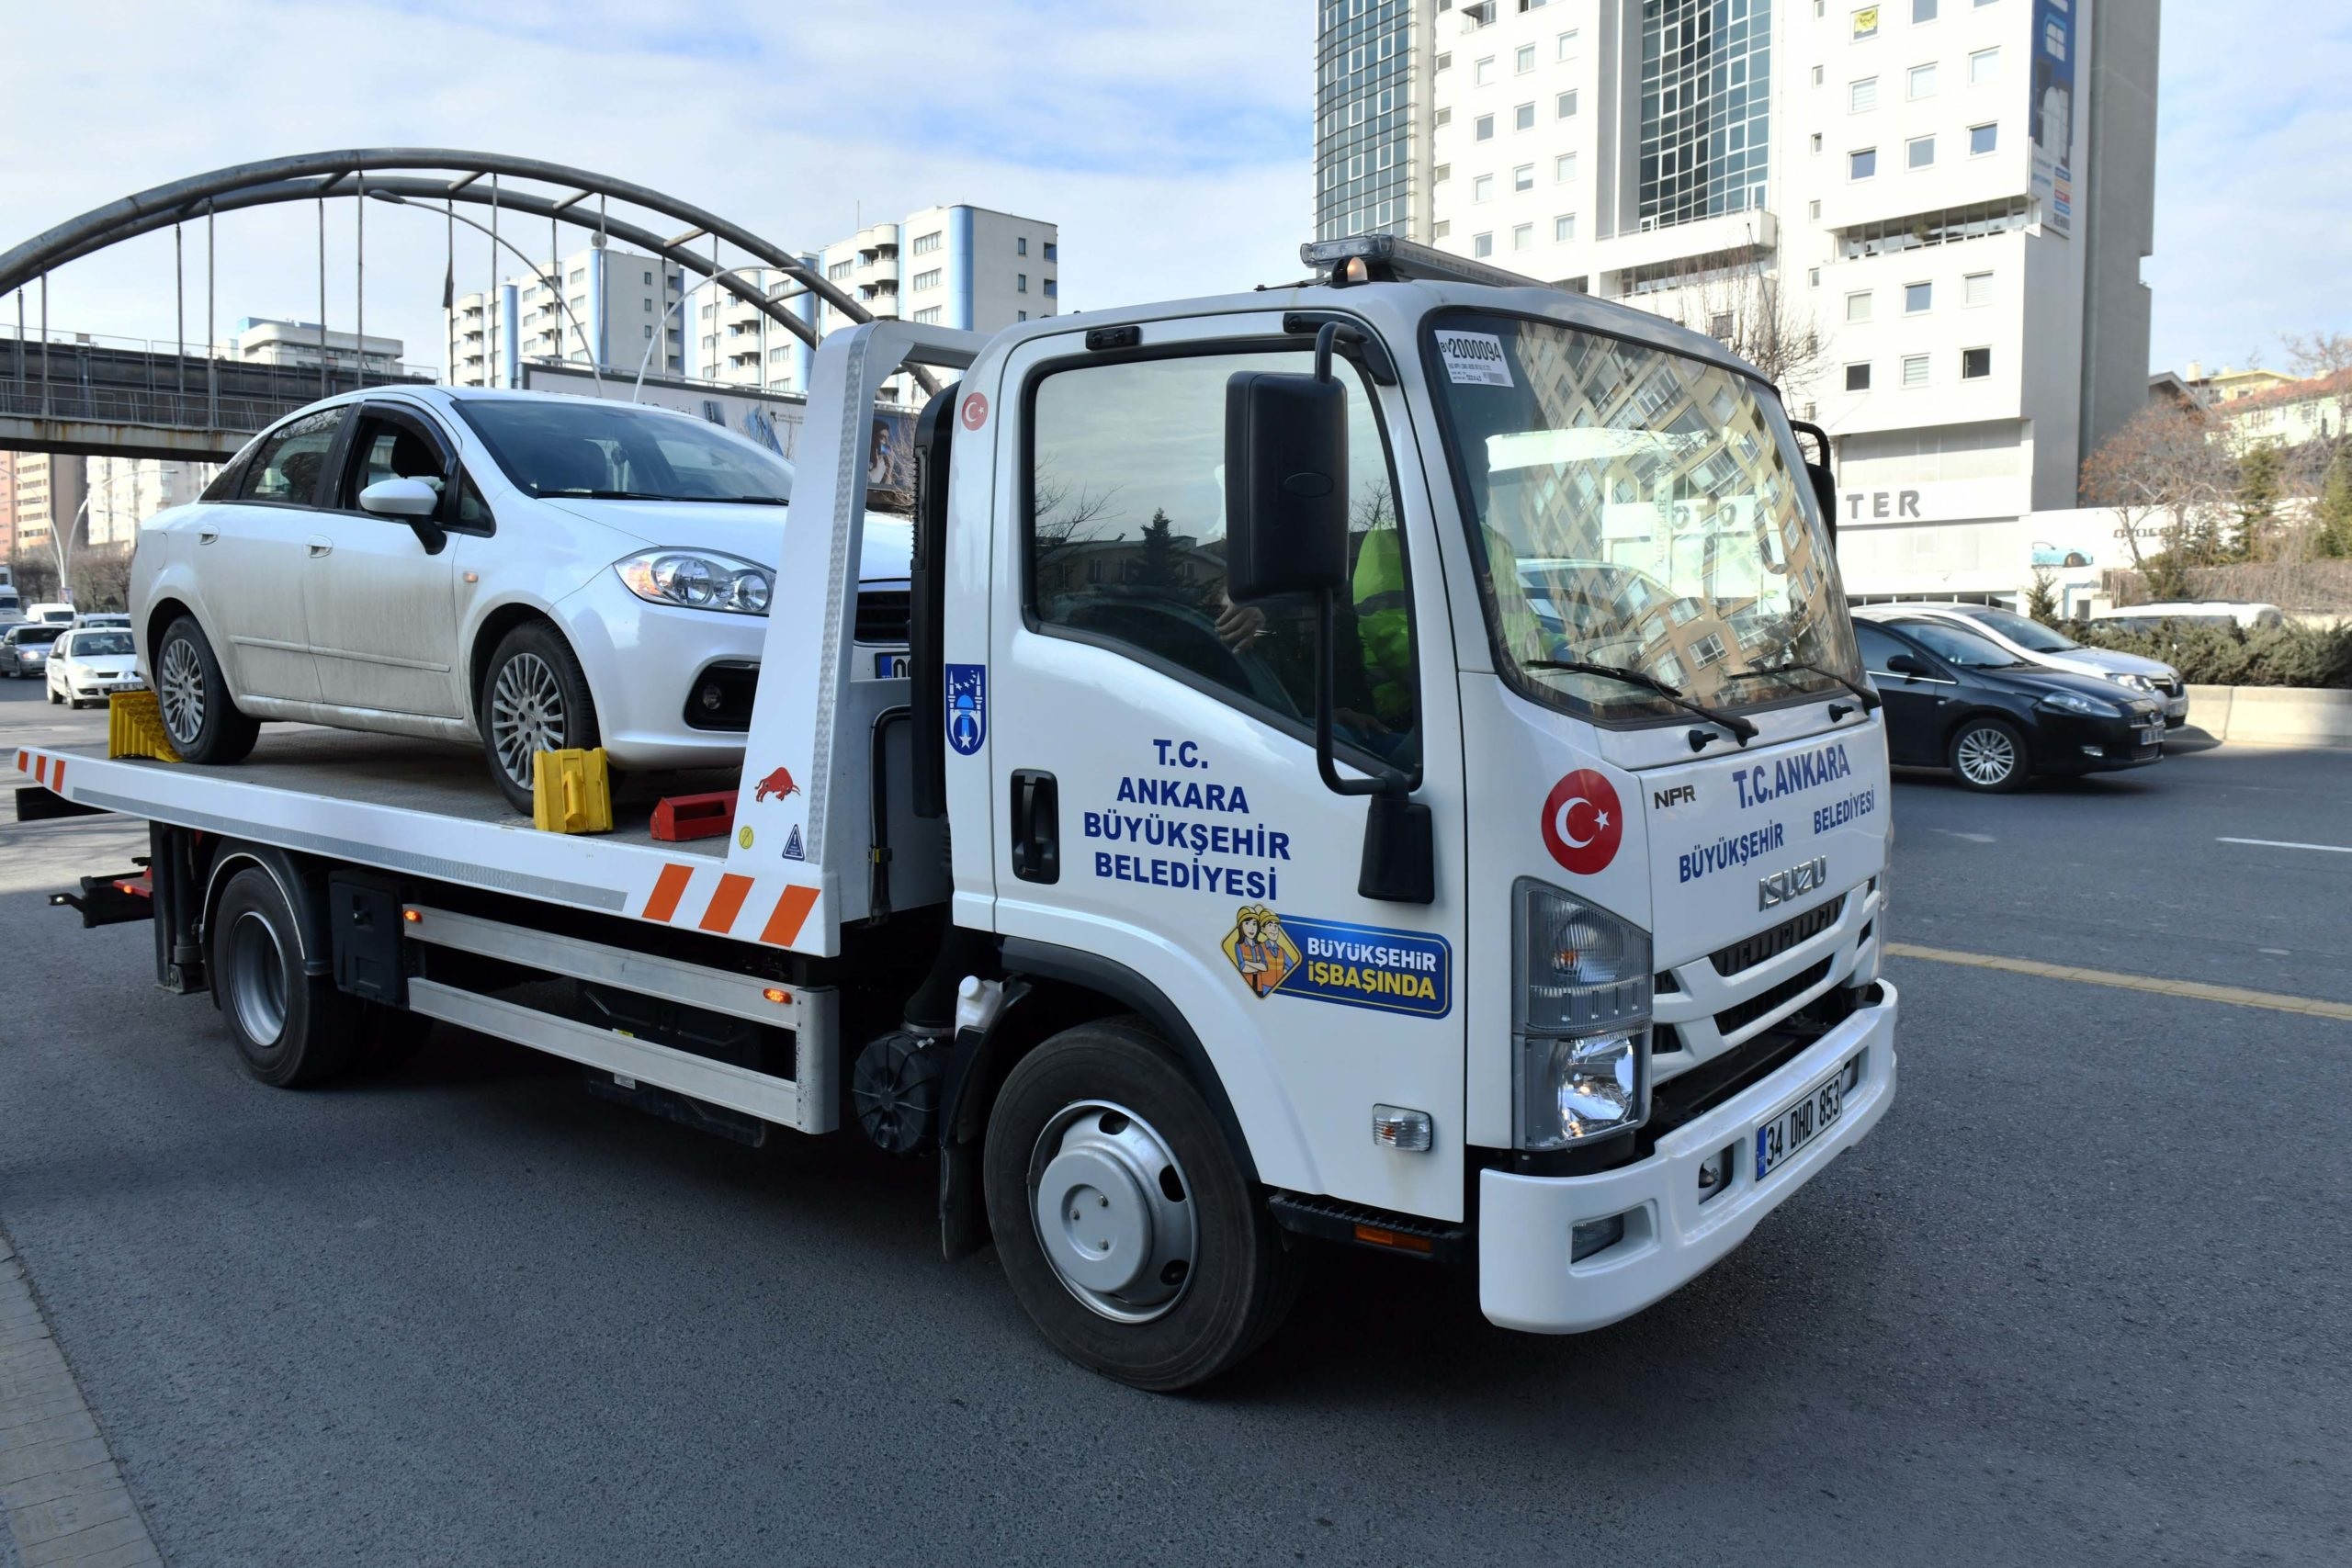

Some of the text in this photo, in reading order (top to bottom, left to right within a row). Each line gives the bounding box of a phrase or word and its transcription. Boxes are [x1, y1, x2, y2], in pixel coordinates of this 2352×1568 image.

[1846, 490, 1921, 519] TER
[1153, 739, 1208, 769] T.C.
[1116, 776, 1250, 814] ANKARA
[1654, 784, 1696, 810] NPR
[1084, 808, 1291, 861] BÜYÜKŞEHİR
[1679, 784, 1875, 884] BÜYÜKŞEHİR BELEDİYESİ
[1095, 852, 1276, 901] BELEDİYESİ
[1758, 854, 1827, 913] ISUZU
[1767, 1079, 1839, 1166] 34 DHD 853
